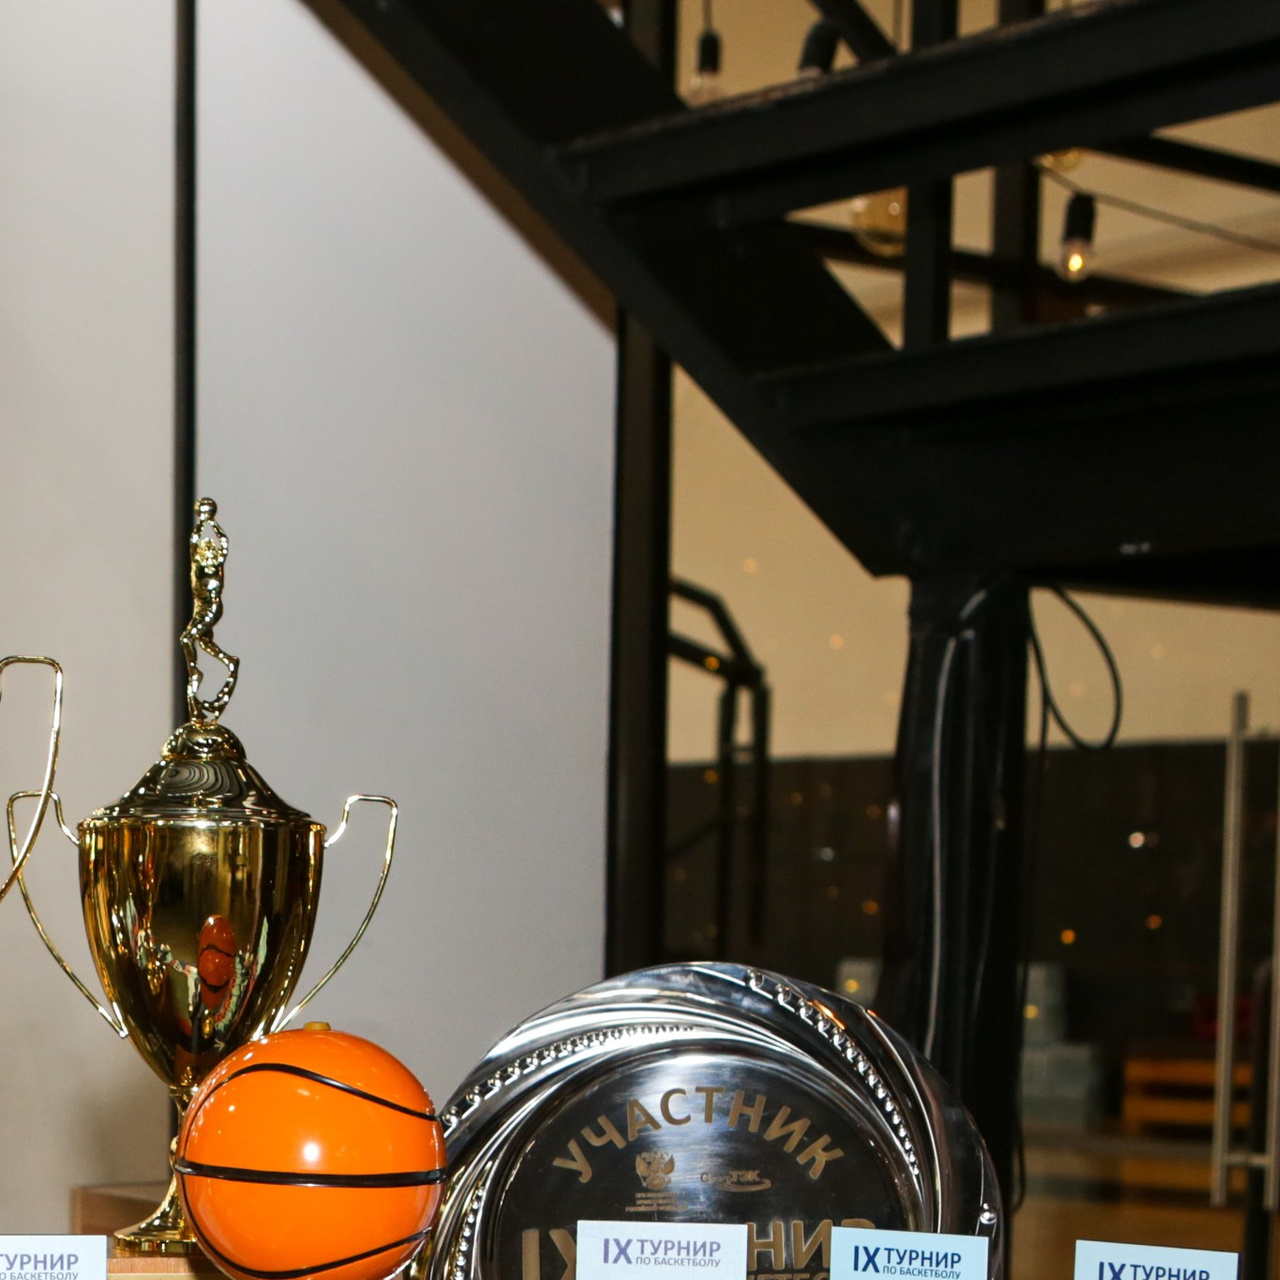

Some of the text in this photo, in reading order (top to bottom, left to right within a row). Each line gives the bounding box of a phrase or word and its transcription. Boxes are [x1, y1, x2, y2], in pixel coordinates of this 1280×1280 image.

[553, 1085, 845, 1184] УЧАСТНИК
[602, 1238, 633, 1265] IX
[635, 1239, 721, 1258] ТУРНИР
[635, 1256, 721, 1268] ПО БАСКЕТБОЛУ
[853, 1245, 880, 1273] IX
[883, 1247, 962, 1270] ТУРНИР
[9, 1271, 79, 1280] БАСКЕТБОЛУ
[882, 1265, 962, 1280] ПО БАСКЕТБОЛУ
